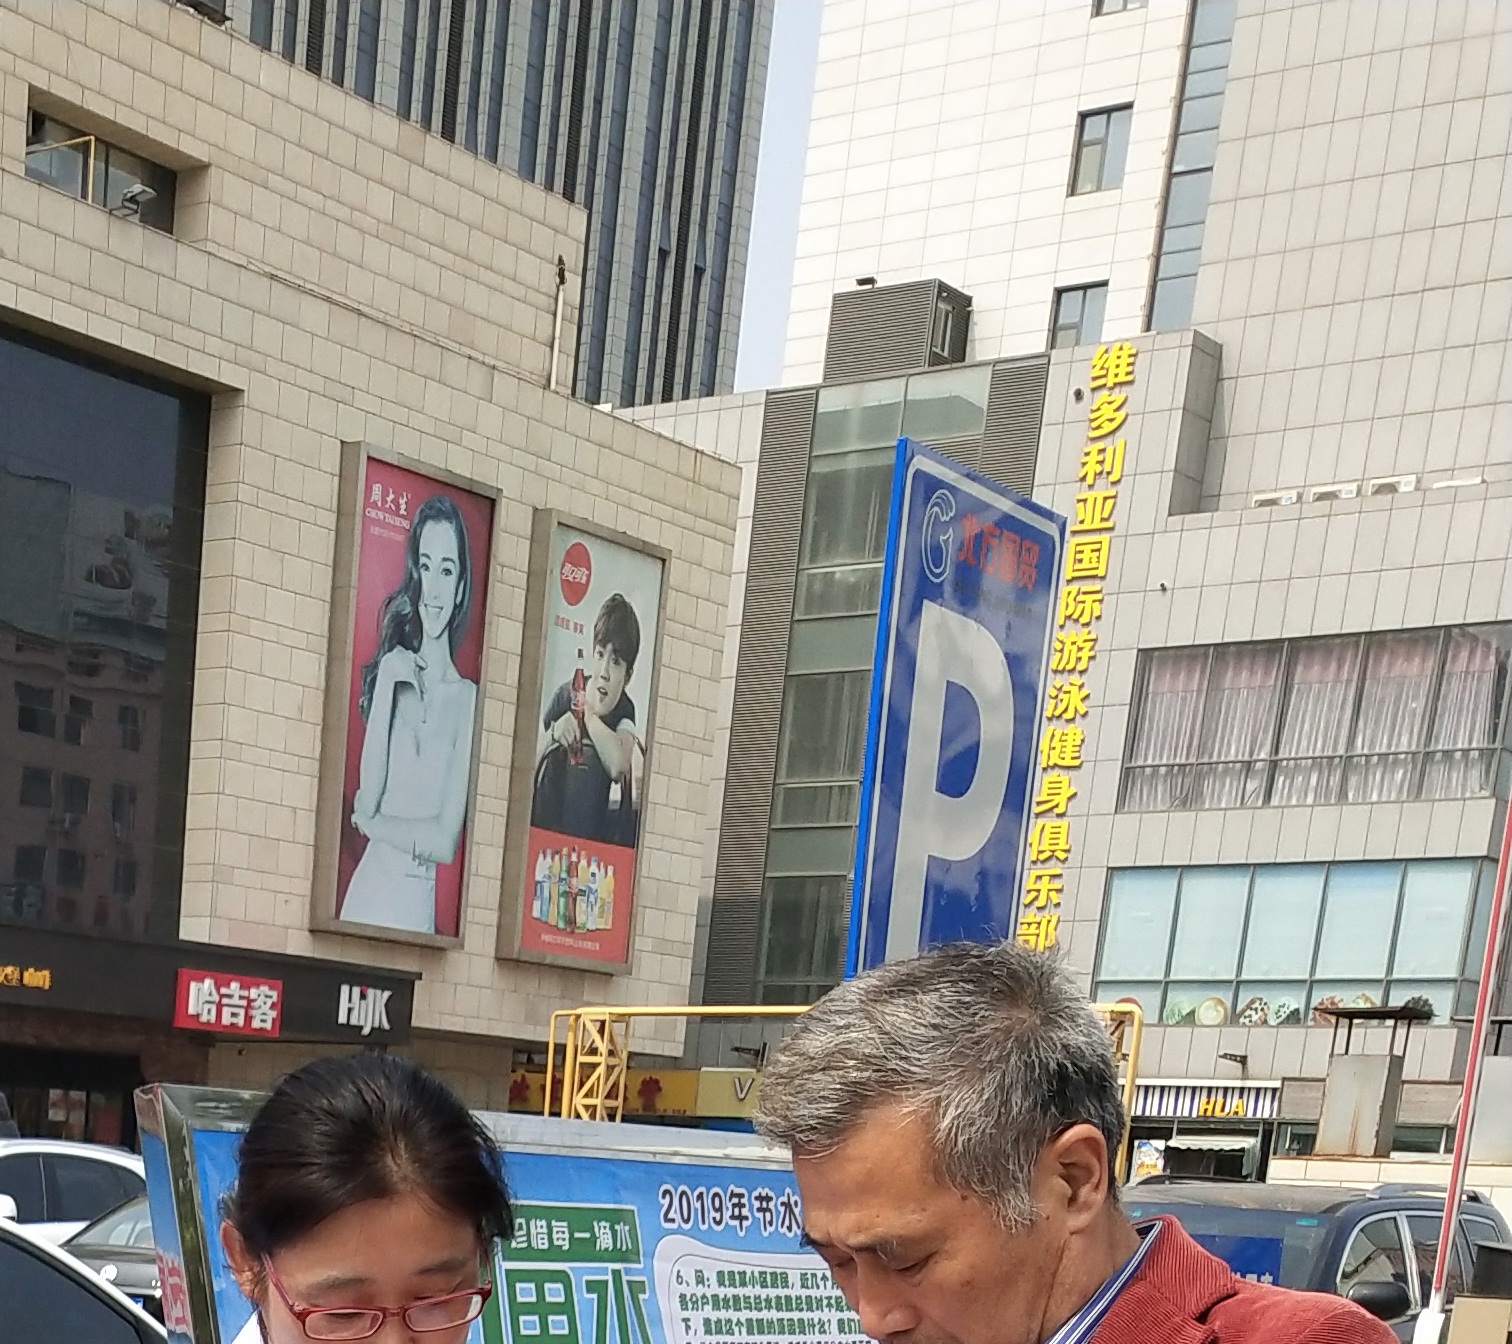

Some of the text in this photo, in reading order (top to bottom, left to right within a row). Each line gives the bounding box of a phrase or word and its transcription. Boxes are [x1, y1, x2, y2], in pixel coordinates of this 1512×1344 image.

[1017, 341, 1137, 952] 维多利亚国际游泳健身俱乐部
[885, 599, 1015, 958] P
[188, 978, 279, 1031] 哈吉客
[1198, 1098, 1245, 1117] HLA
[661, 1188, 801, 1234] 2019年节水
